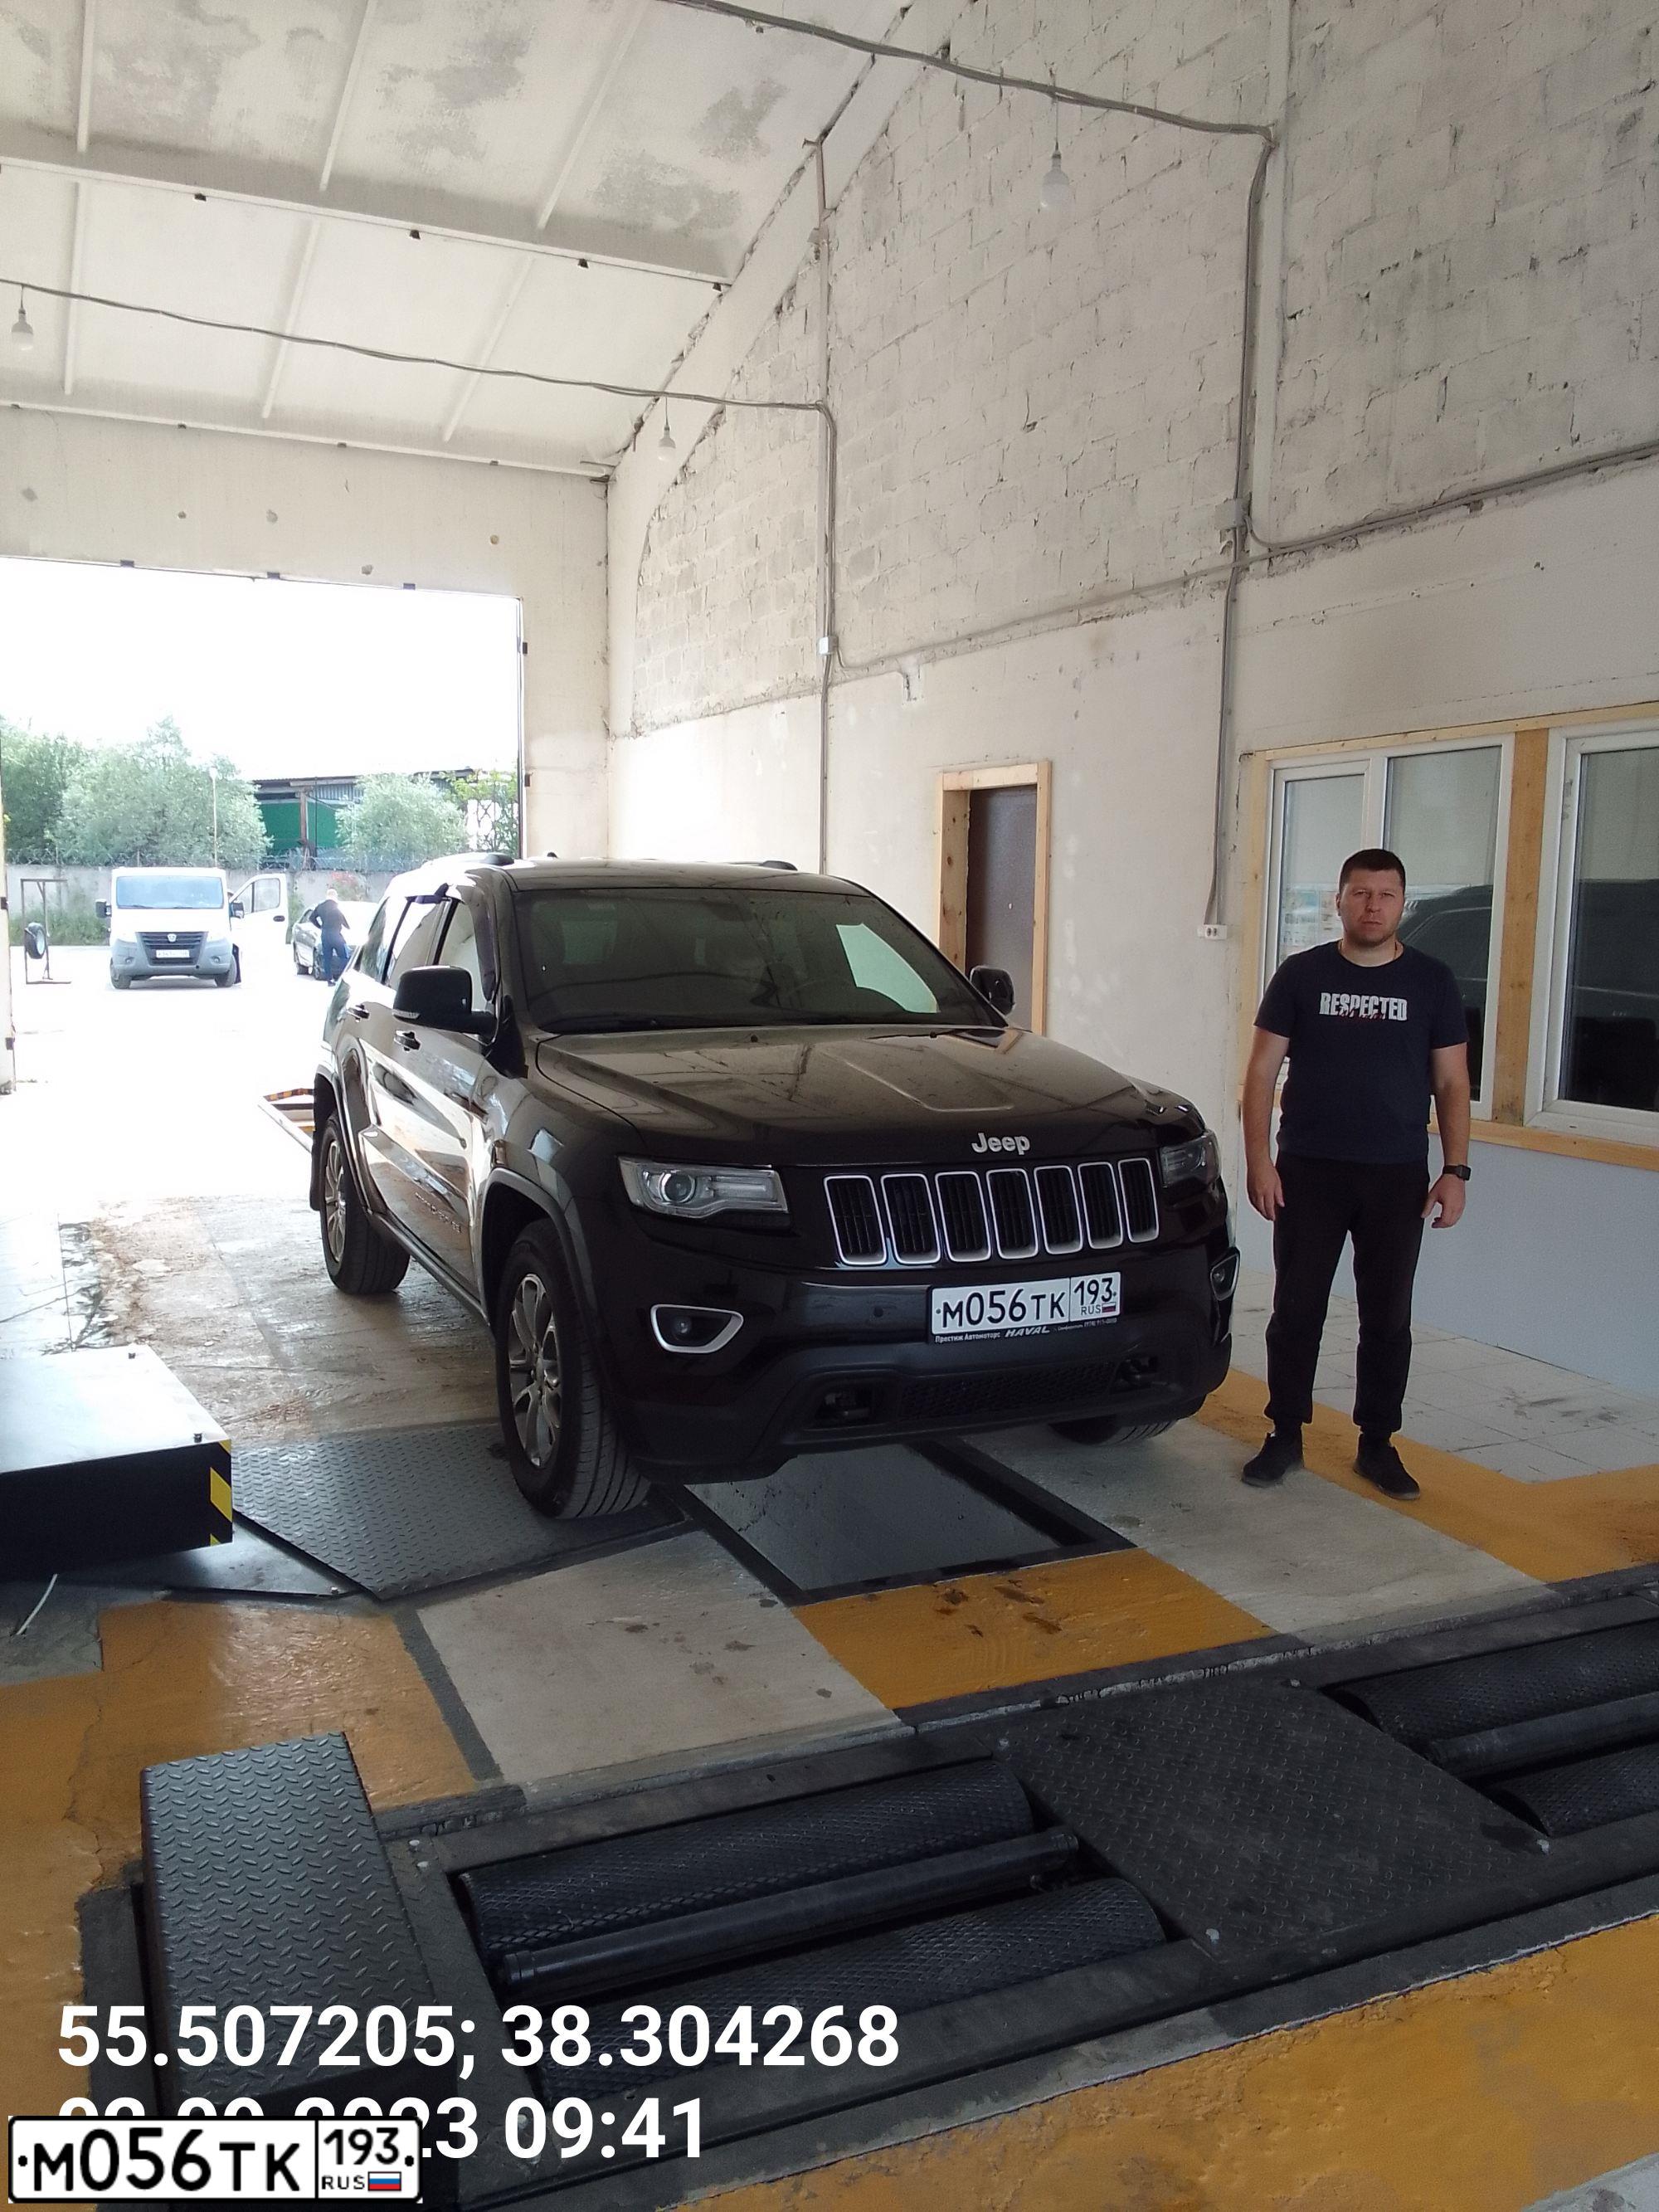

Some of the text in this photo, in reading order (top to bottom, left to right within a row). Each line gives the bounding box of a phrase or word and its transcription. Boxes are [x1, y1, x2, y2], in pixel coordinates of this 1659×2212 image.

[1319, 992, 1408, 1021] RESPECTED
[971, 1132, 1030, 1156] Jeep
[1073, 1277, 1114, 1306] 193
[1080, 1303, 1102, 1316] RUS
[1004, 1325, 1051, 1338] HAVAL
